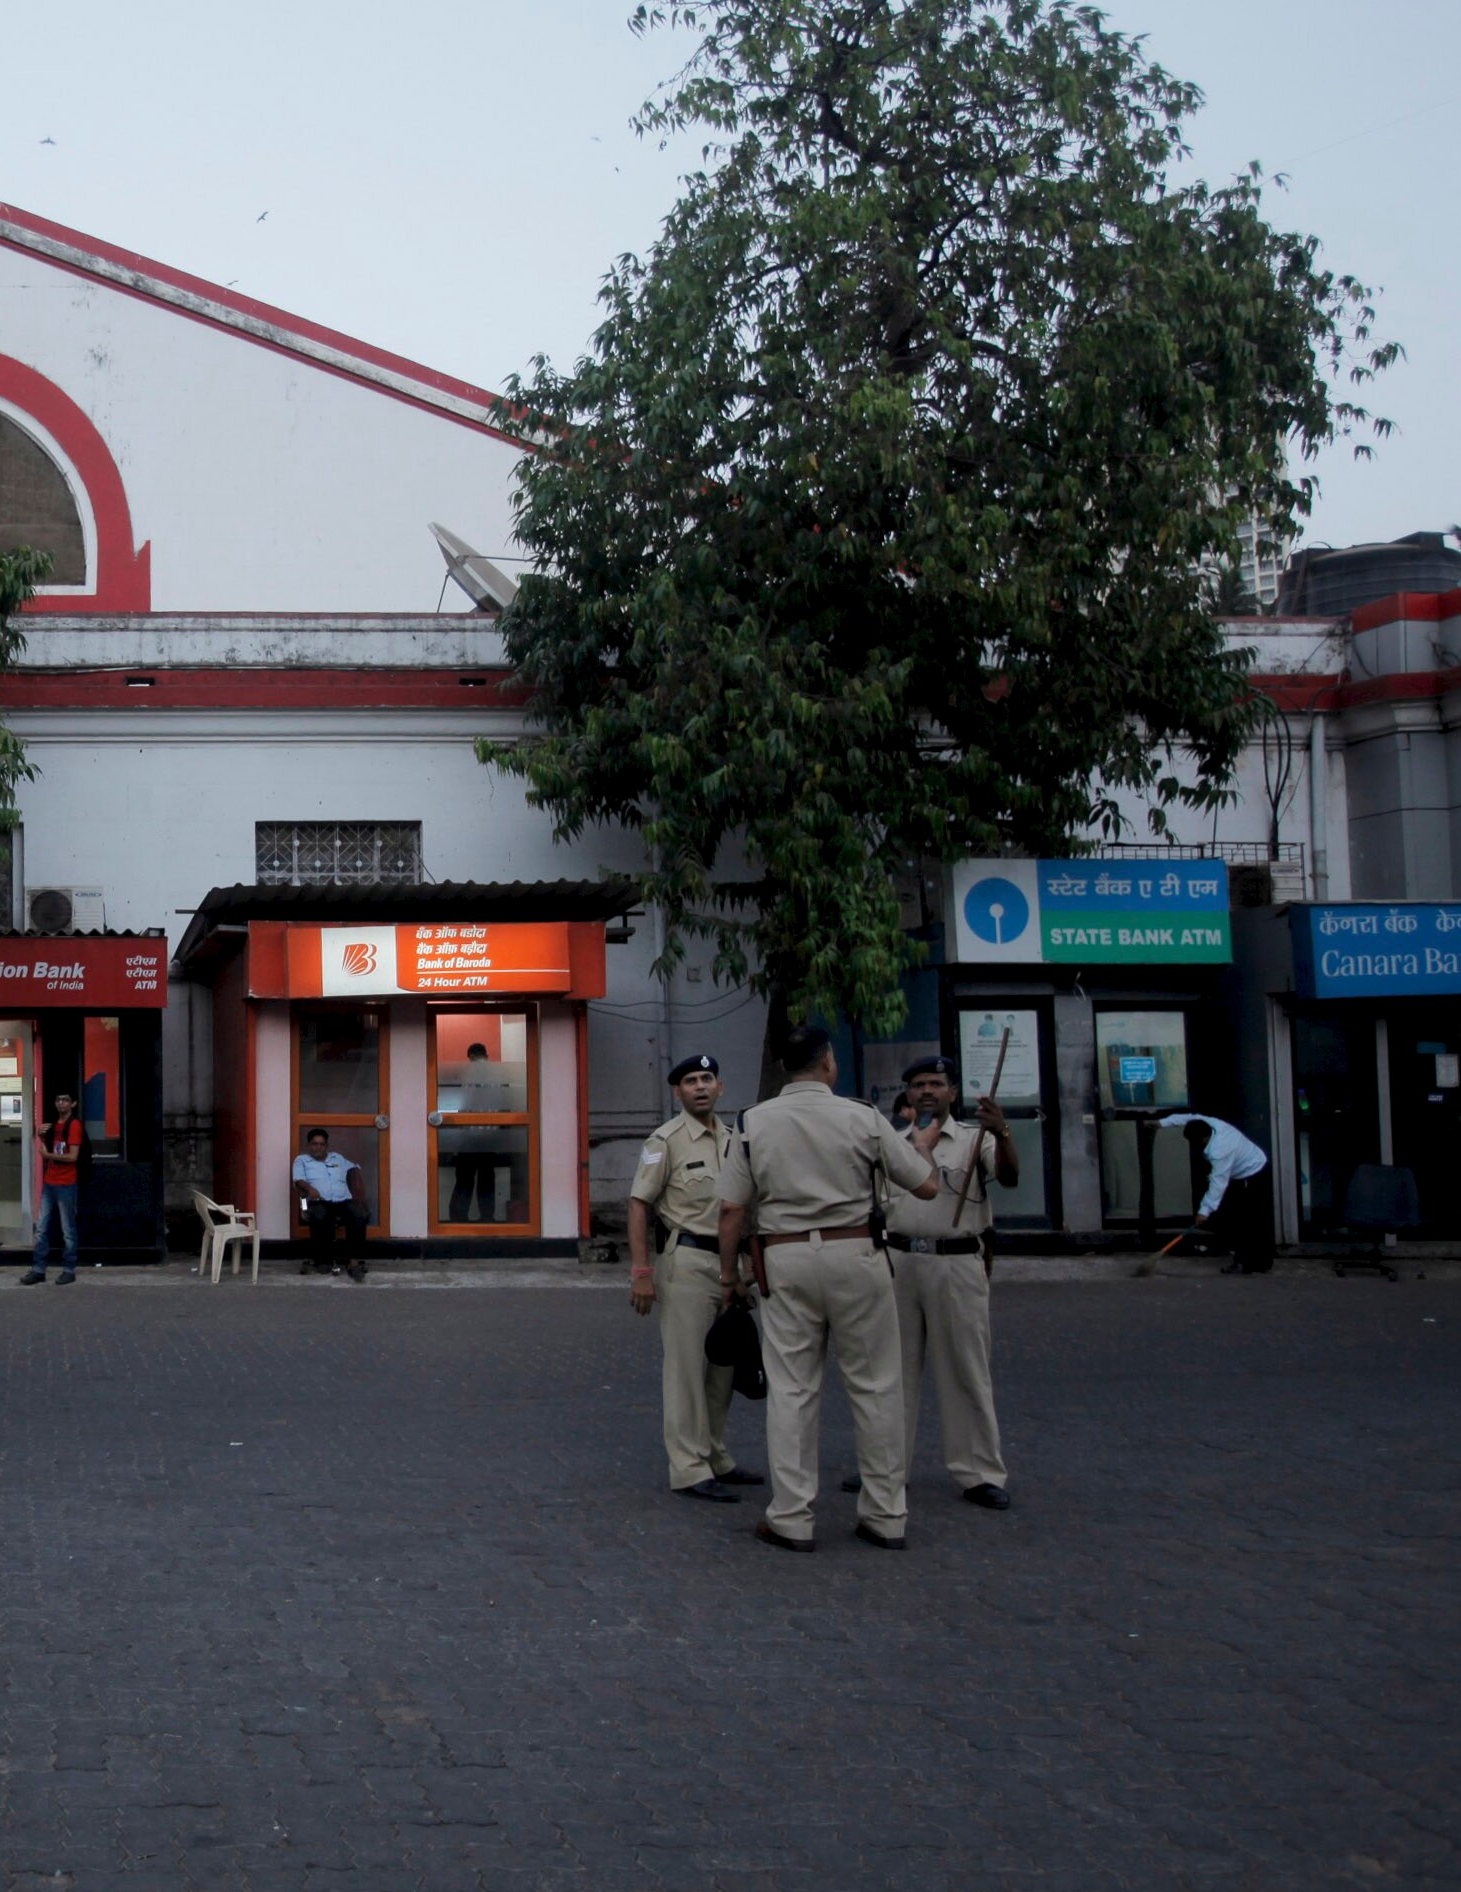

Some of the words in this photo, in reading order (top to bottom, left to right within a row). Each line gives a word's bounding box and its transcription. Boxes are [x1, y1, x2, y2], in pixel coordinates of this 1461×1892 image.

[1047, 874, 1088, 896] स्टेट
[1094, 872, 1132, 896] बैंक
[1138, 880, 1152, 898] ए
[1159, 873, 1180, 896] टी
[1187, 880, 1218, 898] एम
[1050, 928, 1113, 945] STATE
[1118, 929, 1175, 945] BANK
[1181, 929, 1222, 945] ATM
[126, 955, 157, 966] एटीएम
[417, 958, 444, 969] Bank
[444, 957, 455, 969] of
[456, 957, 491, 968] Baroda
[1321, 949, 1419, 977] Canara
[1423, 947, 1461, 975] Ba
[33, 961, 85, 978] Bank
[126, 967, 157, 978] एटीएम
[47, 980, 58, 990] of
[59, 980, 84, 990] India
[134, 980, 157, 990] ATM
[418, 978, 431, 987] 24
[434, 977, 460, 987] Hour
[463, 976, 488, 986] ATM
